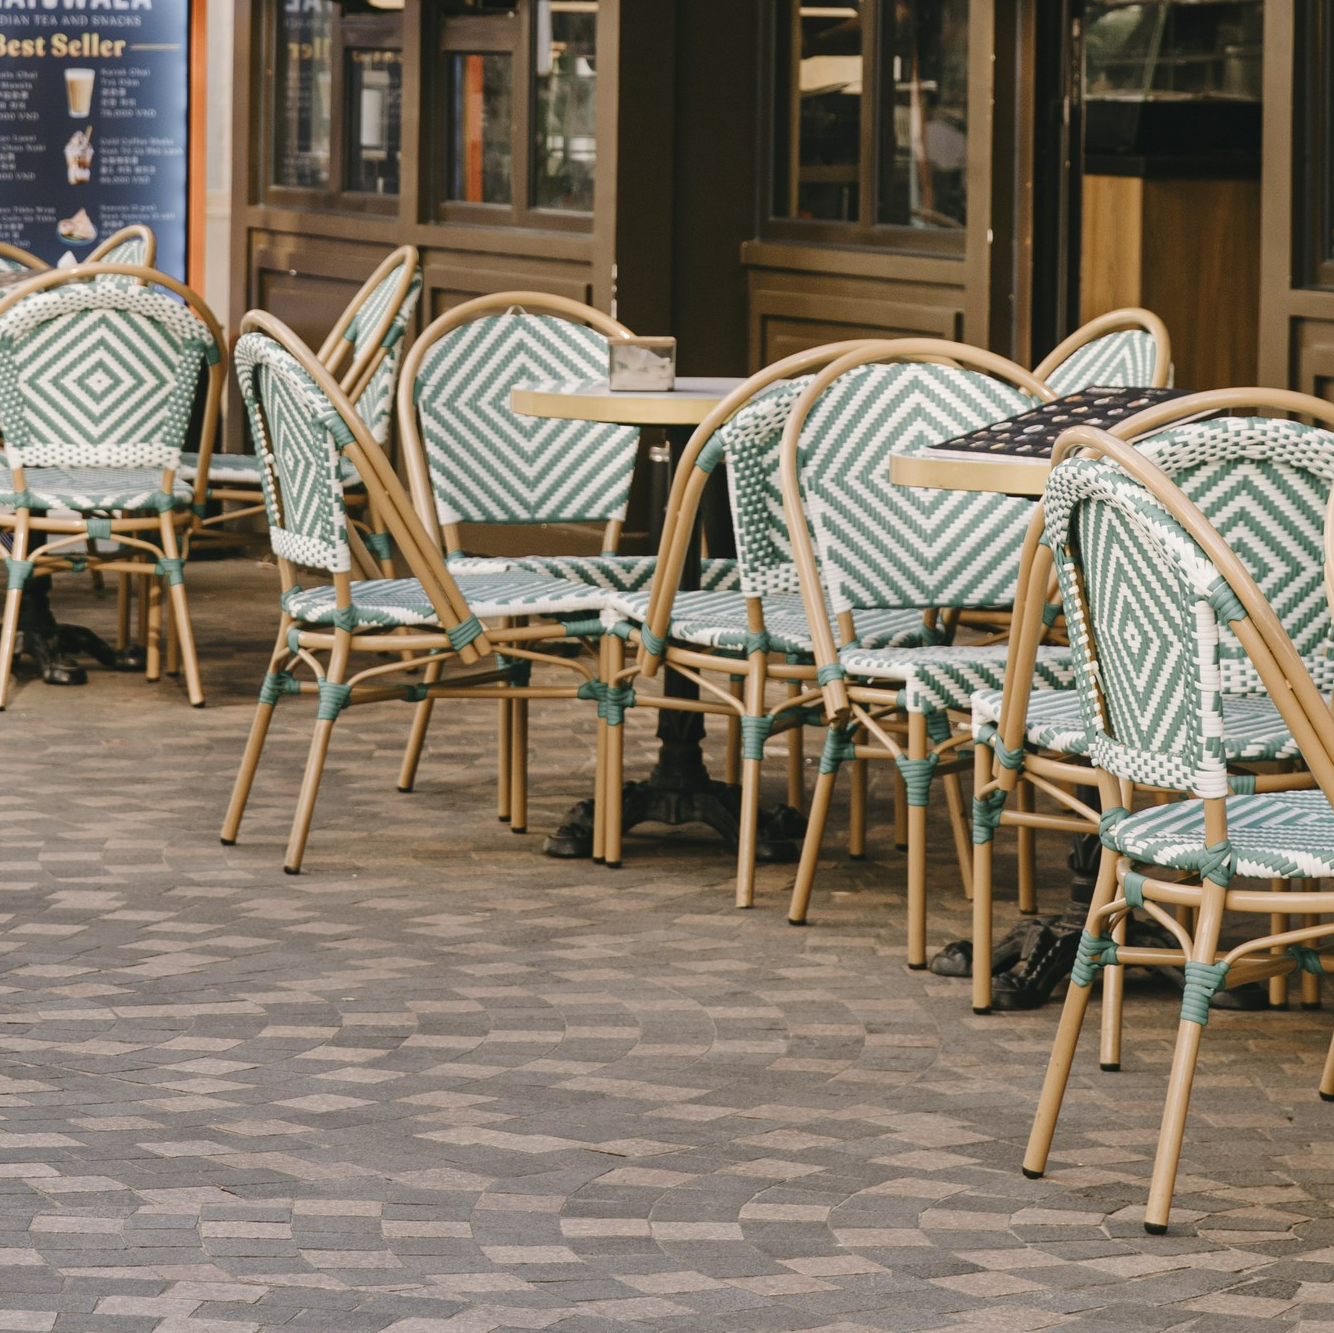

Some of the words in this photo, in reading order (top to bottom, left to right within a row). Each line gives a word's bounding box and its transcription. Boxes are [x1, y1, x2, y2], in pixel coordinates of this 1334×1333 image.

[34, 14, 57, 26] TEA
[62, 15, 88, 27] AND
[93, 15, 142, 27] SNACKS
[51, 32, 127, 58] Seller
